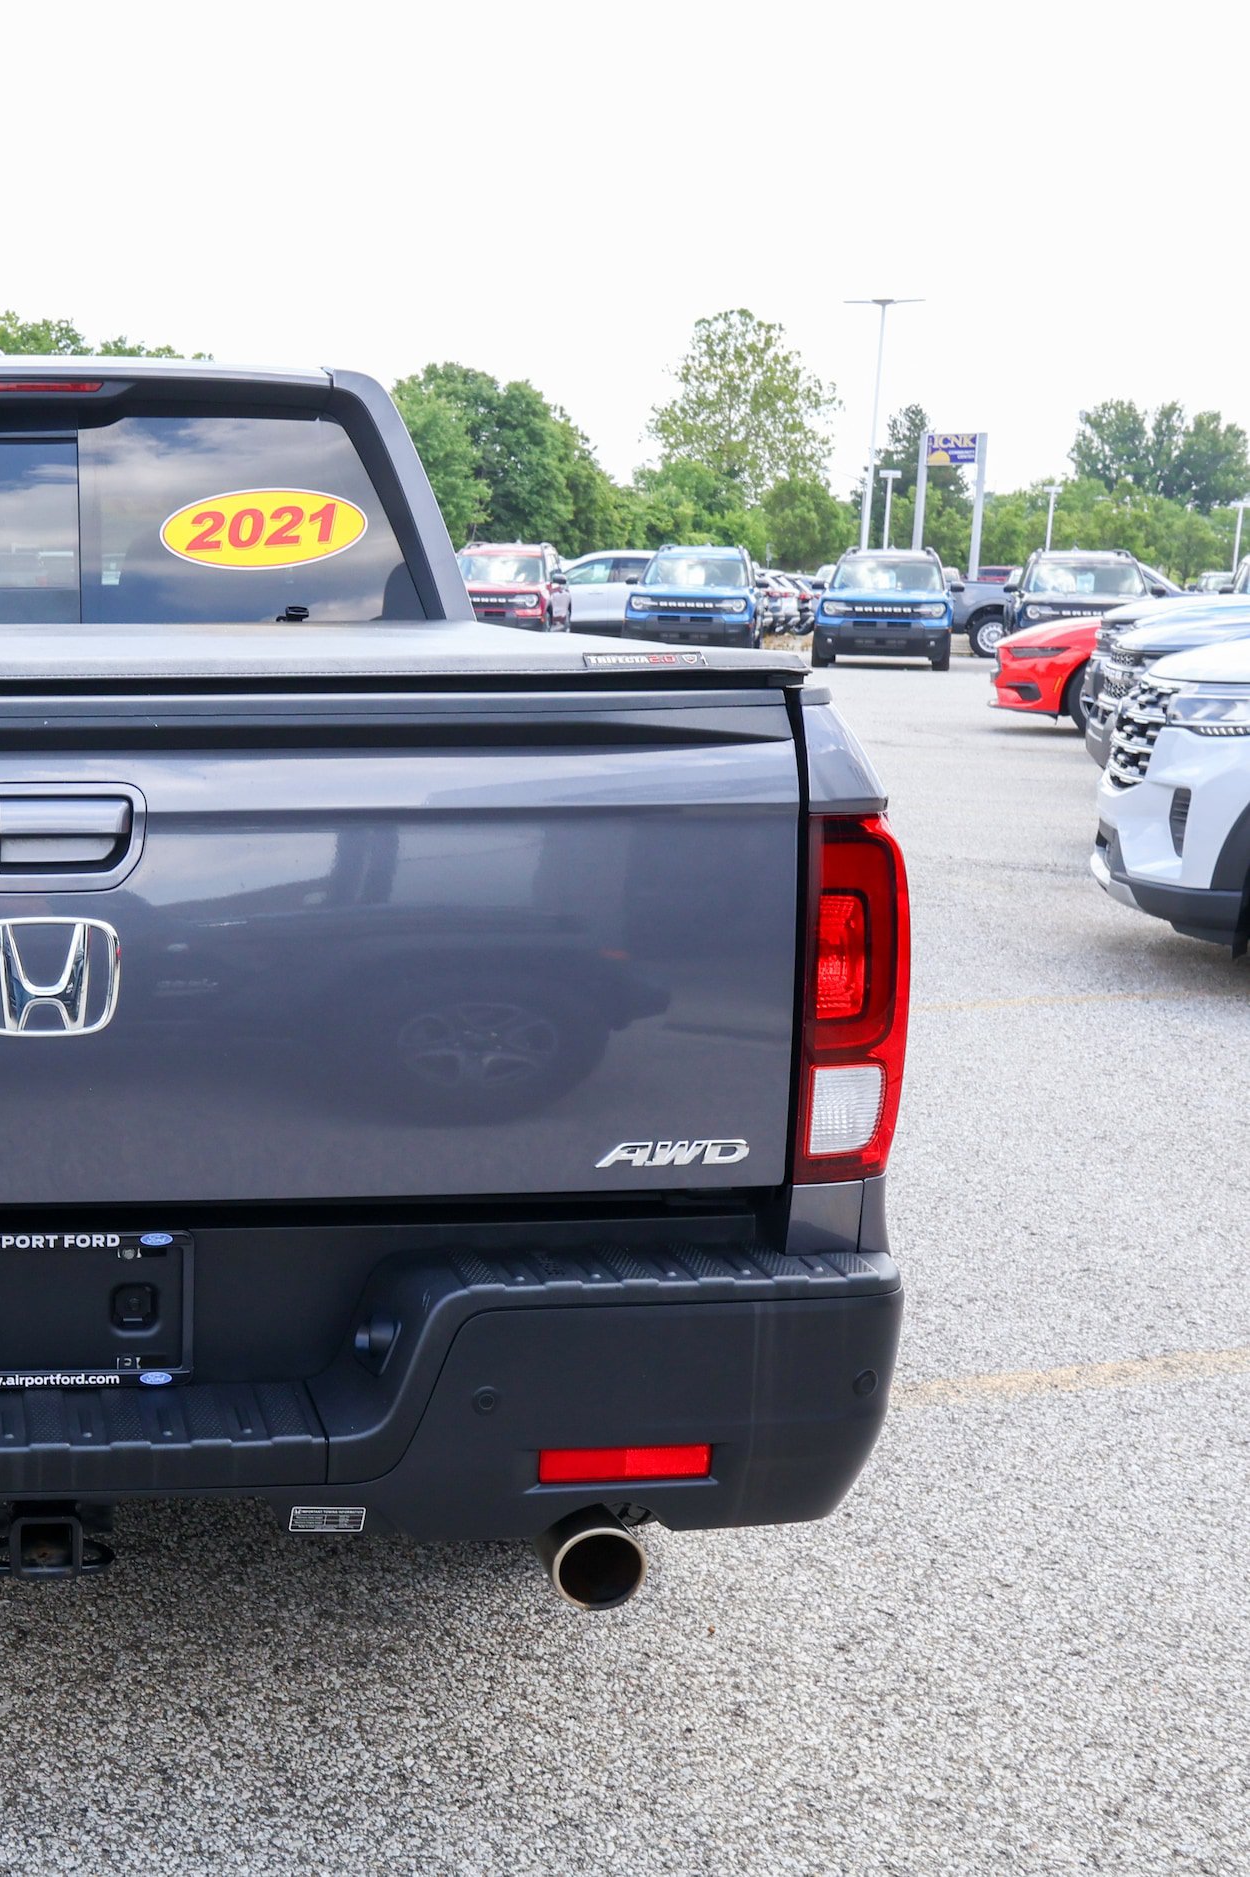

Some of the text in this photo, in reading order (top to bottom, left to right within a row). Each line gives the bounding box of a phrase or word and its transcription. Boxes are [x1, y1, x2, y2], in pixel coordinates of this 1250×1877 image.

[933, 434, 976, 449] ICNK
[185, 503, 338, 553] 2021
[658, 600, 714, 609] BRONCO
[594, 1138, 750, 1169] AWD
[63, 1234, 120, 1248] FORD
